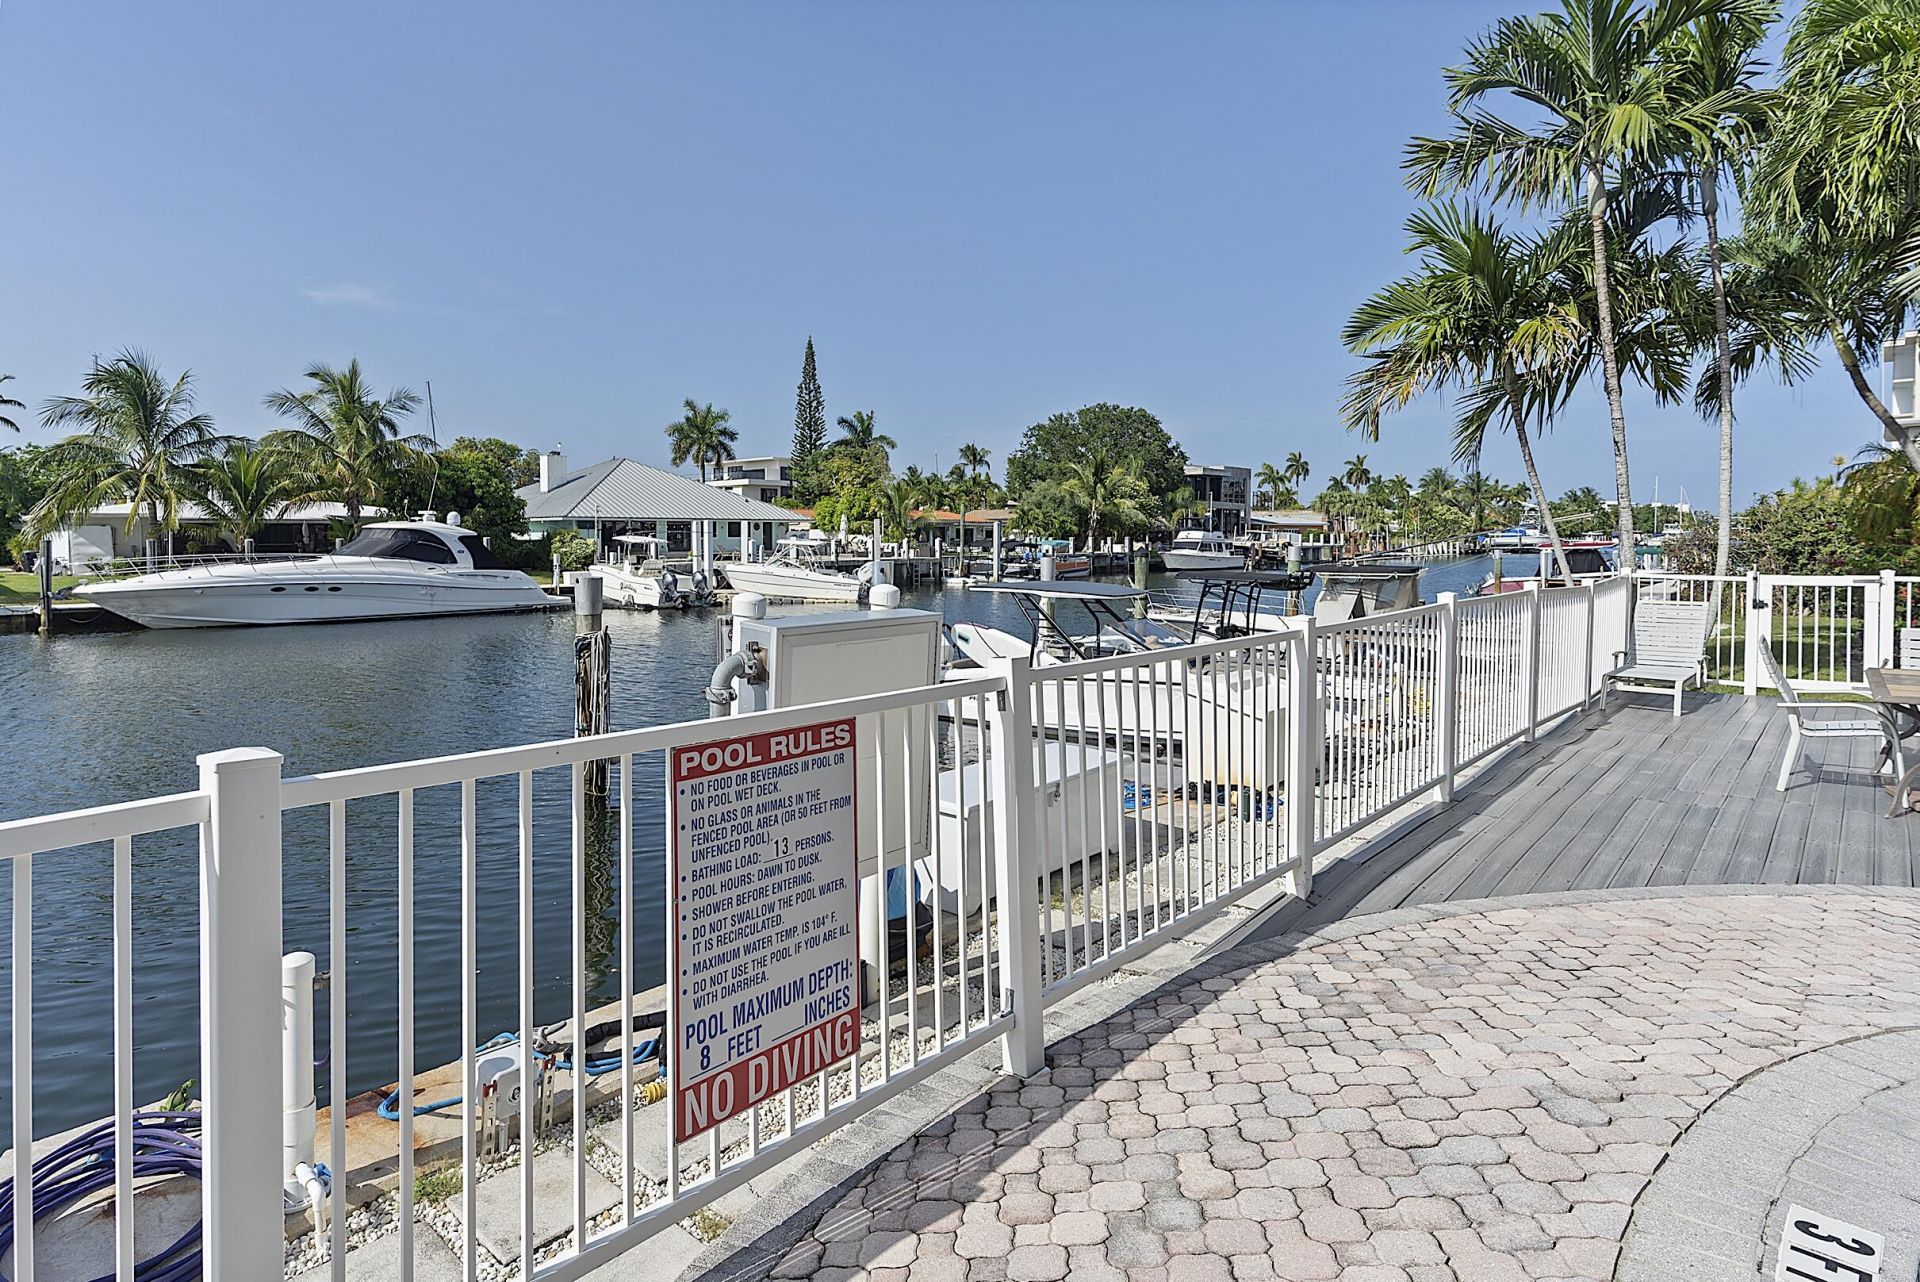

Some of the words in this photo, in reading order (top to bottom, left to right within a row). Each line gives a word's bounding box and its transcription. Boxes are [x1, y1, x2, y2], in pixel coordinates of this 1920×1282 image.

[681, 742, 761, 776] POOL
[770, 724, 850, 759] RULES
[691, 782, 704, 796] NO
[708, 777, 732, 794] FOOD
[736, 773, 748, 787] OR
[751, 762, 798, 783] BEVERAGES
[801, 762, 809, 772] IN
[812, 756, 832, 770] POOL
[834, 753, 845, 765] OR
[691, 797, 704, 812] ON
[708, 793, 732, 809] POOL
[735, 787, 754, 801] WET
[757, 782, 781, 797] DECK.
[692, 817, 704, 832] NO
[708, 810, 737, 827] GLASS
[741, 806, 753, 819] OR
[756, 796, 793, 816] ANIMALS
[795, 794, 803, 805] IN
[806, 789, 820, 801] THE
[692, 829, 727, 847] FENCED
[730, 820, 754, 837] POOL
[757, 814, 779, 830] AREA
[782, 811, 796, 826] (OR
[798, 807, 808, 819] 50
[810, 801, 827, 815] FEET
[830, 795, 851, 811] FROM
[692, 839, 740, 863] UNFENCED
[744, 831, 773, 849] POOL).
[692, 860, 732, 882] BATHING
[735, 853, 761, 869] LOAD:
[774, 837, 789, 857] 13
[795, 831, 834, 851] PERSONS.
[692, 884, 717, 900] POOL
[721, 874, 754, 892] HOURS:
[758, 865, 782, 881] DAWN
[786, 860, 795, 872] TO
[798, 852, 822, 868] DUSK.
[692, 898, 733, 921] SHOWER
[736, 888, 769, 906] BEFORE
[772, 872, 814, 897] ENTERING.
[692, 942, 702, 956] IT
[705, 939, 714, 951] IS
[716, 914, 784, 948] RECIRCULATED.
[693, 926, 706, 940] DO
[709, 918, 728, 937] NOT
[731, 902, 775, 930] SWALLOW
[777, 896, 793, 910] THE
[796, 887, 816, 903] POOL
[693, 948, 740, 975] MAXIMUM
[743, 935, 772, 956] WATER
[776, 926, 799, 944] TEMP.
[802, 922, 810, 934] IS
[831, 912, 837, 923] F.
[693, 980, 706, 994] DO
[709, 972, 728, 990] NOT
[732, 965, 749, 981] USE
[751, 957, 768, 973] THE
[770, 948, 791, 966] POOL
[795, 942, 802, 954] IF
[804, 935, 820, 952] YOU
[822, 929, 837, 944] ARE
[840, 923, 850, 937] ILL
[686, 1011, 727, 1049] POOL
[733, 978, 804, 1029] MAXIMUM
[809, 958, 853, 995] DEPTH:
[694, 990, 718, 1010] WITH
[721, 971, 769, 1001] DIARRHEA.
[700, 1045, 710, 1070] 8
[728, 1025, 762, 1059] FEET
[804, 986, 850, 1025] INCHES
[684, 1071, 734, 1136] NO
[750, 1015, 853, 1102] DIVING
